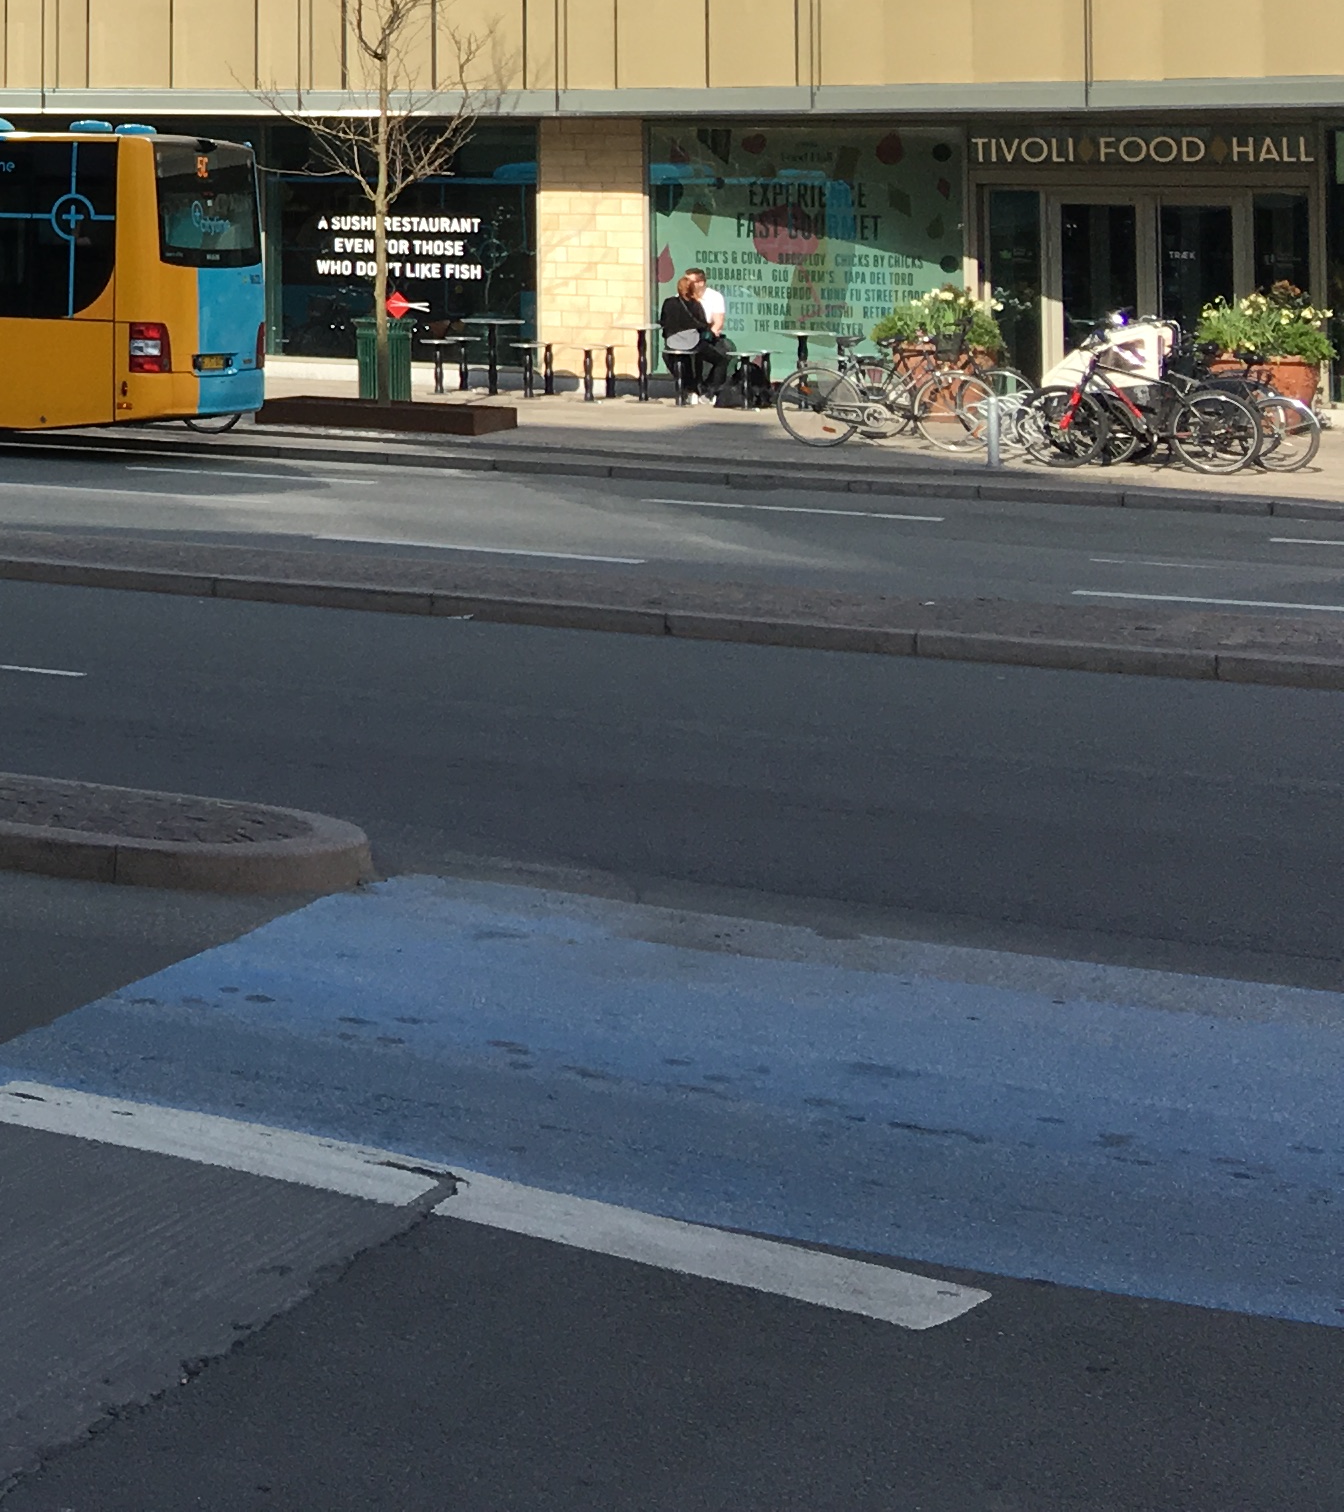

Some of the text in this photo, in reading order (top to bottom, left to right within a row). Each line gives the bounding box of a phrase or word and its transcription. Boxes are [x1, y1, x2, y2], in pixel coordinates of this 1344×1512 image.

[971, 136, 1315, 163] TIVOLI FOOD HALL
[317, 215, 482, 234] A SUSHI RESTAURANT
[736, 213, 781, 240] FAST
[334, 238, 465, 256] EVEN OR THOSE
[696, 250, 729, 264] COCK'S
[316, 259, 482, 280] WHO DO'T LIKE FISH
